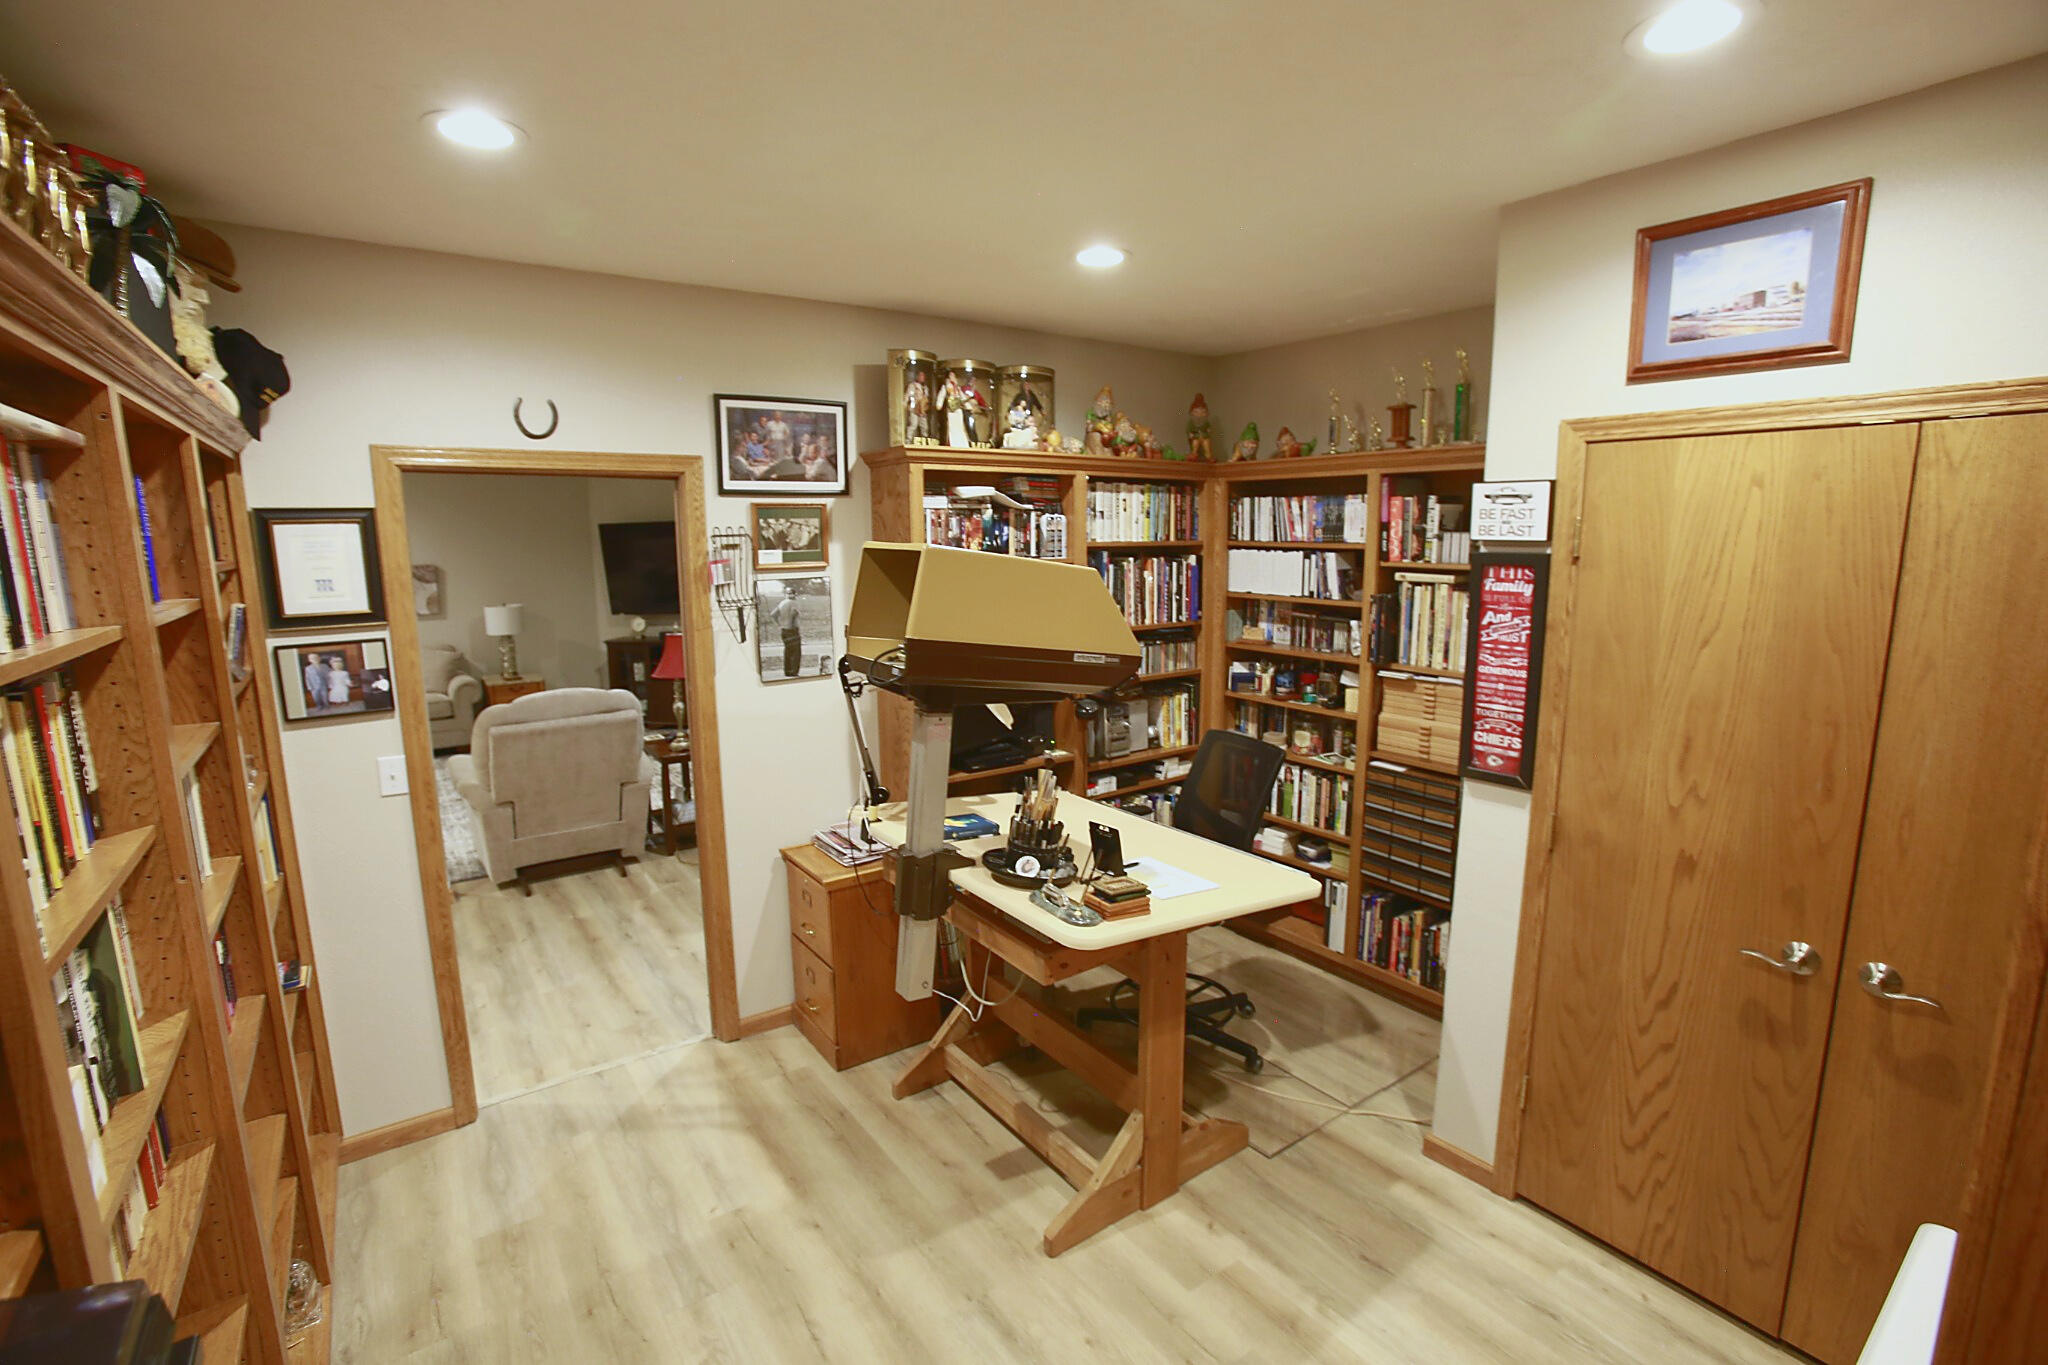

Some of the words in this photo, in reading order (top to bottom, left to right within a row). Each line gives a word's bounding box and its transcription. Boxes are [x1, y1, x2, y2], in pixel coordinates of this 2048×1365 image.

[1479, 508, 1496, 520] BE
[1500, 508, 1536, 520] FAST
[1478, 525, 1496, 536] BE
[1499, 525, 1534, 537] LAST
[1485, 567, 1535, 580] THIS
[1483, 578, 1535, 597] Family
[1481, 610, 1513, 625] And
[1473, 730, 1523, 749] CHIEFS
